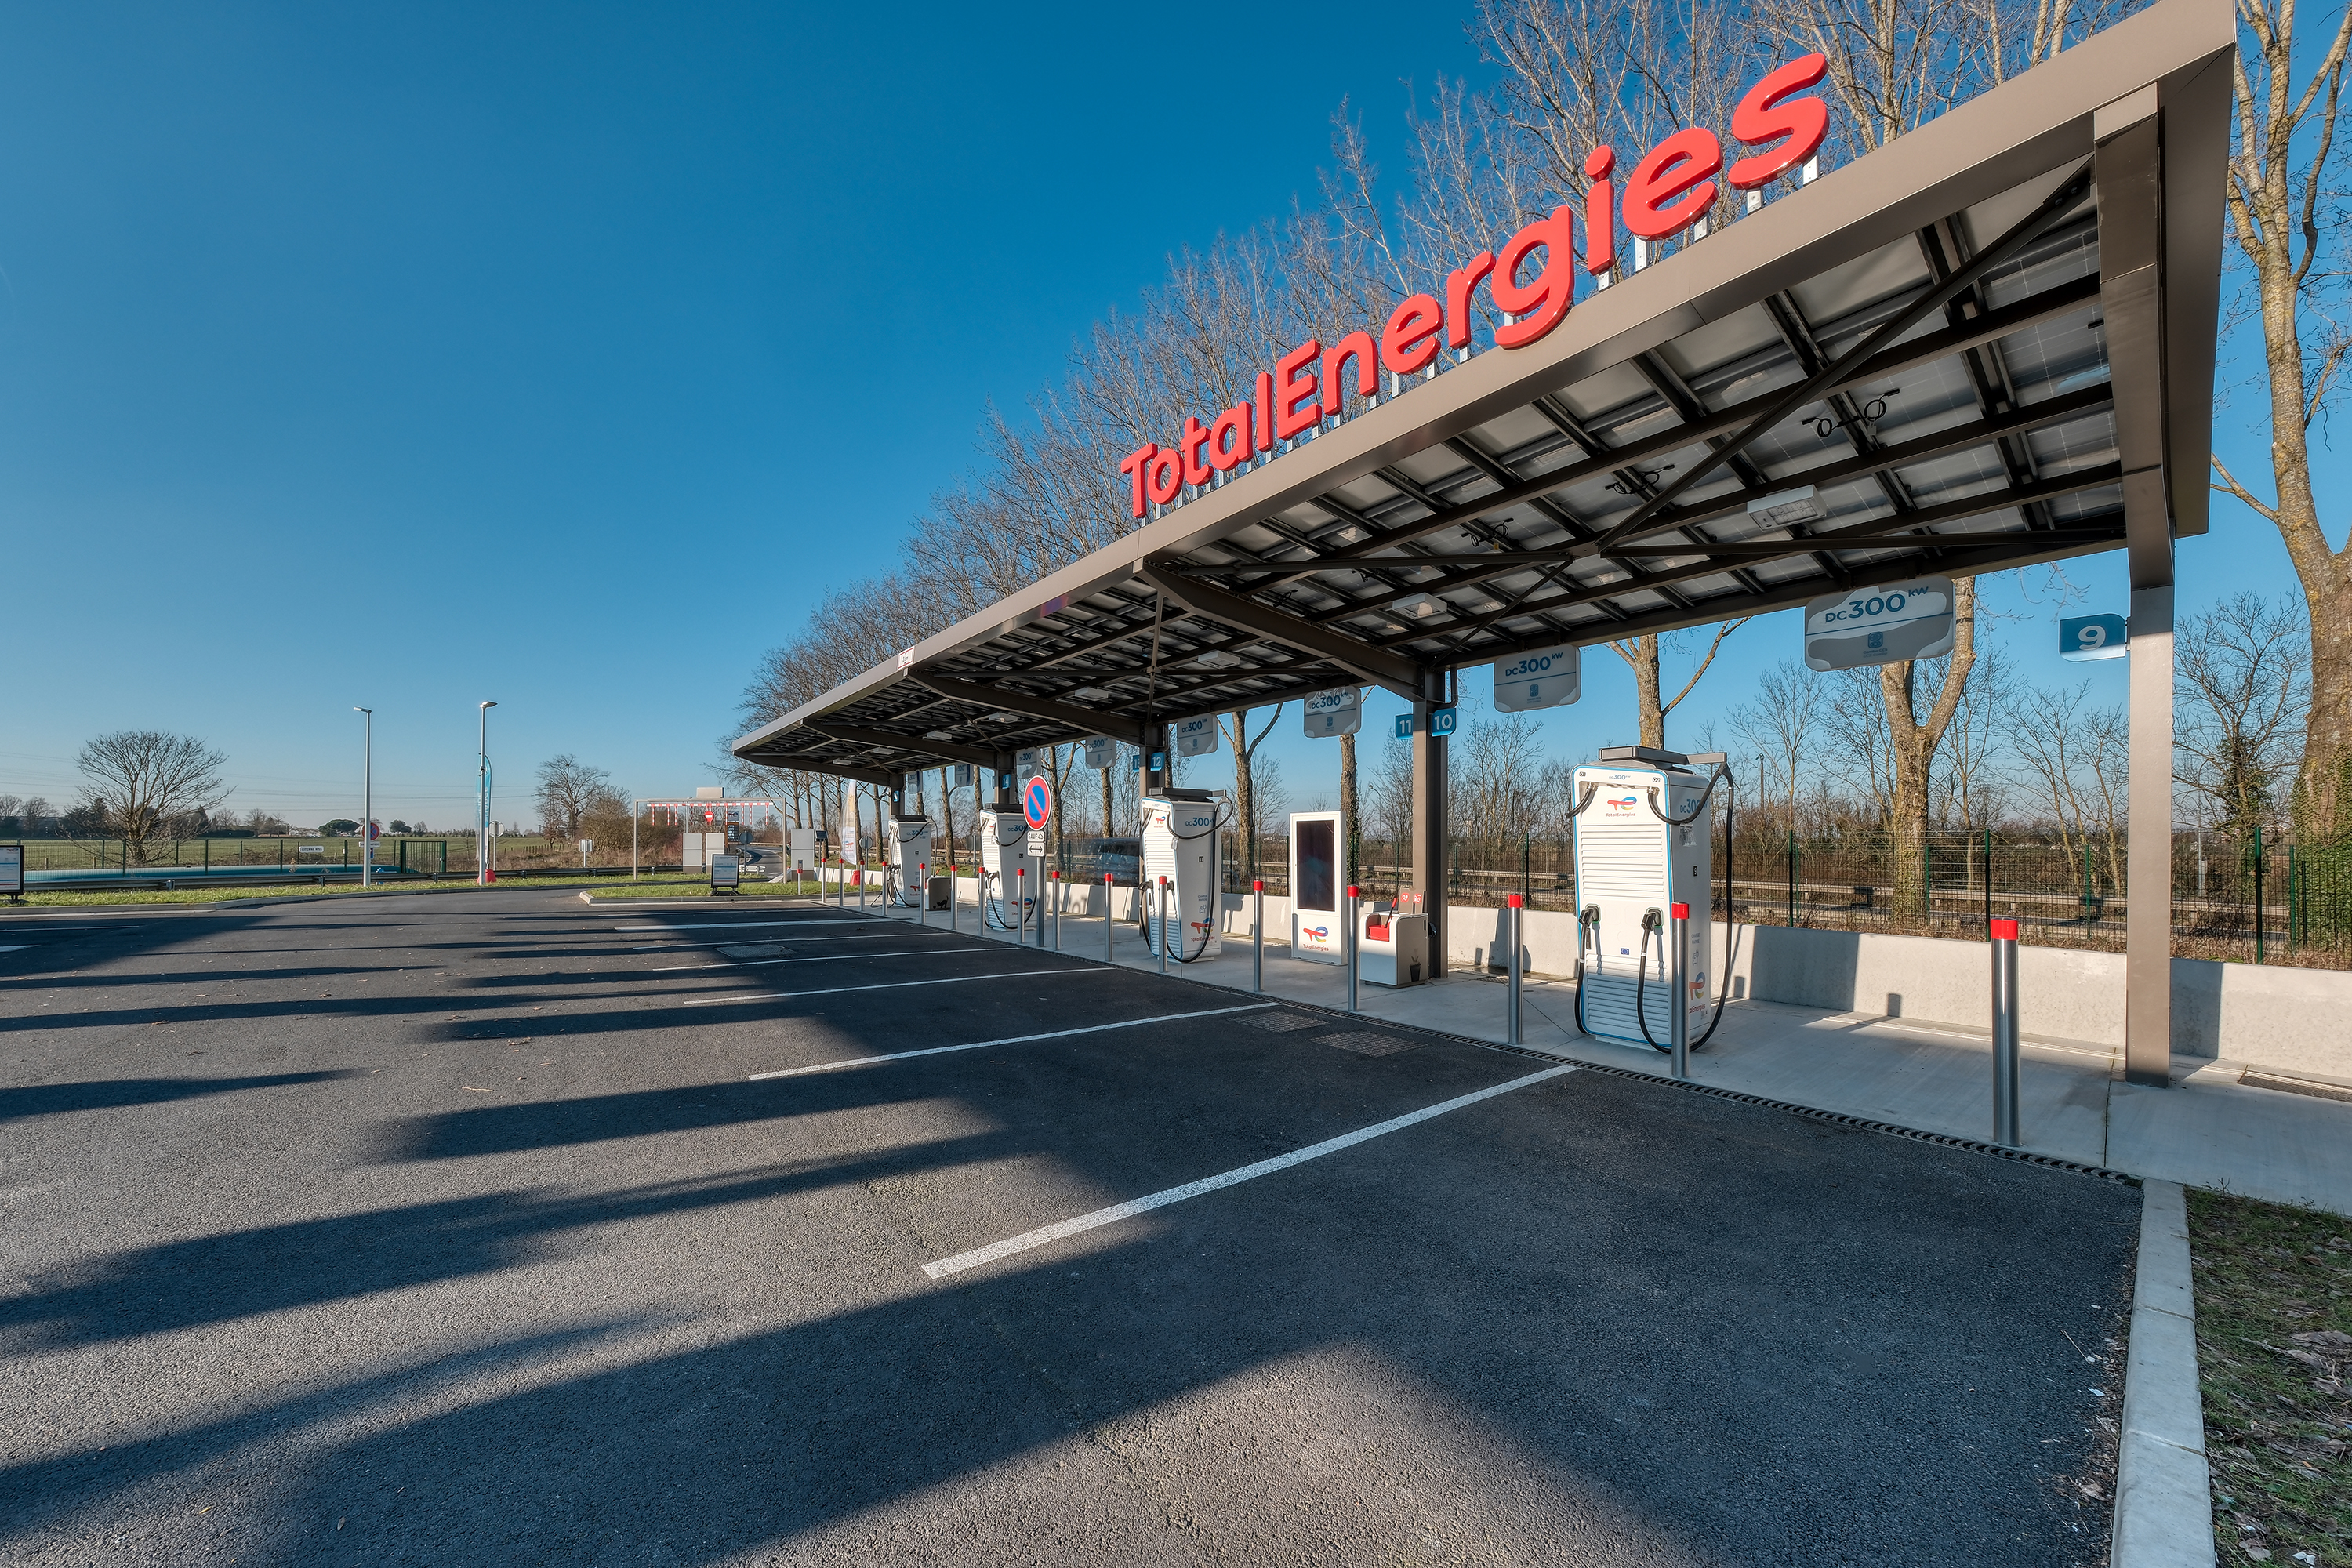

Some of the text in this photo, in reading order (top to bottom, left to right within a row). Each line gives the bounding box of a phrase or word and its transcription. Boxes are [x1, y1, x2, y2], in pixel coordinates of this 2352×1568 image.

[1121, 52, 1830, 519] TotalEnergies
[2078, 625, 2106, 651] 9
[1399, 719, 1412, 735] 11
[1434, 714, 1453, 730] 10
[1152, 756, 1161, 767] 12
